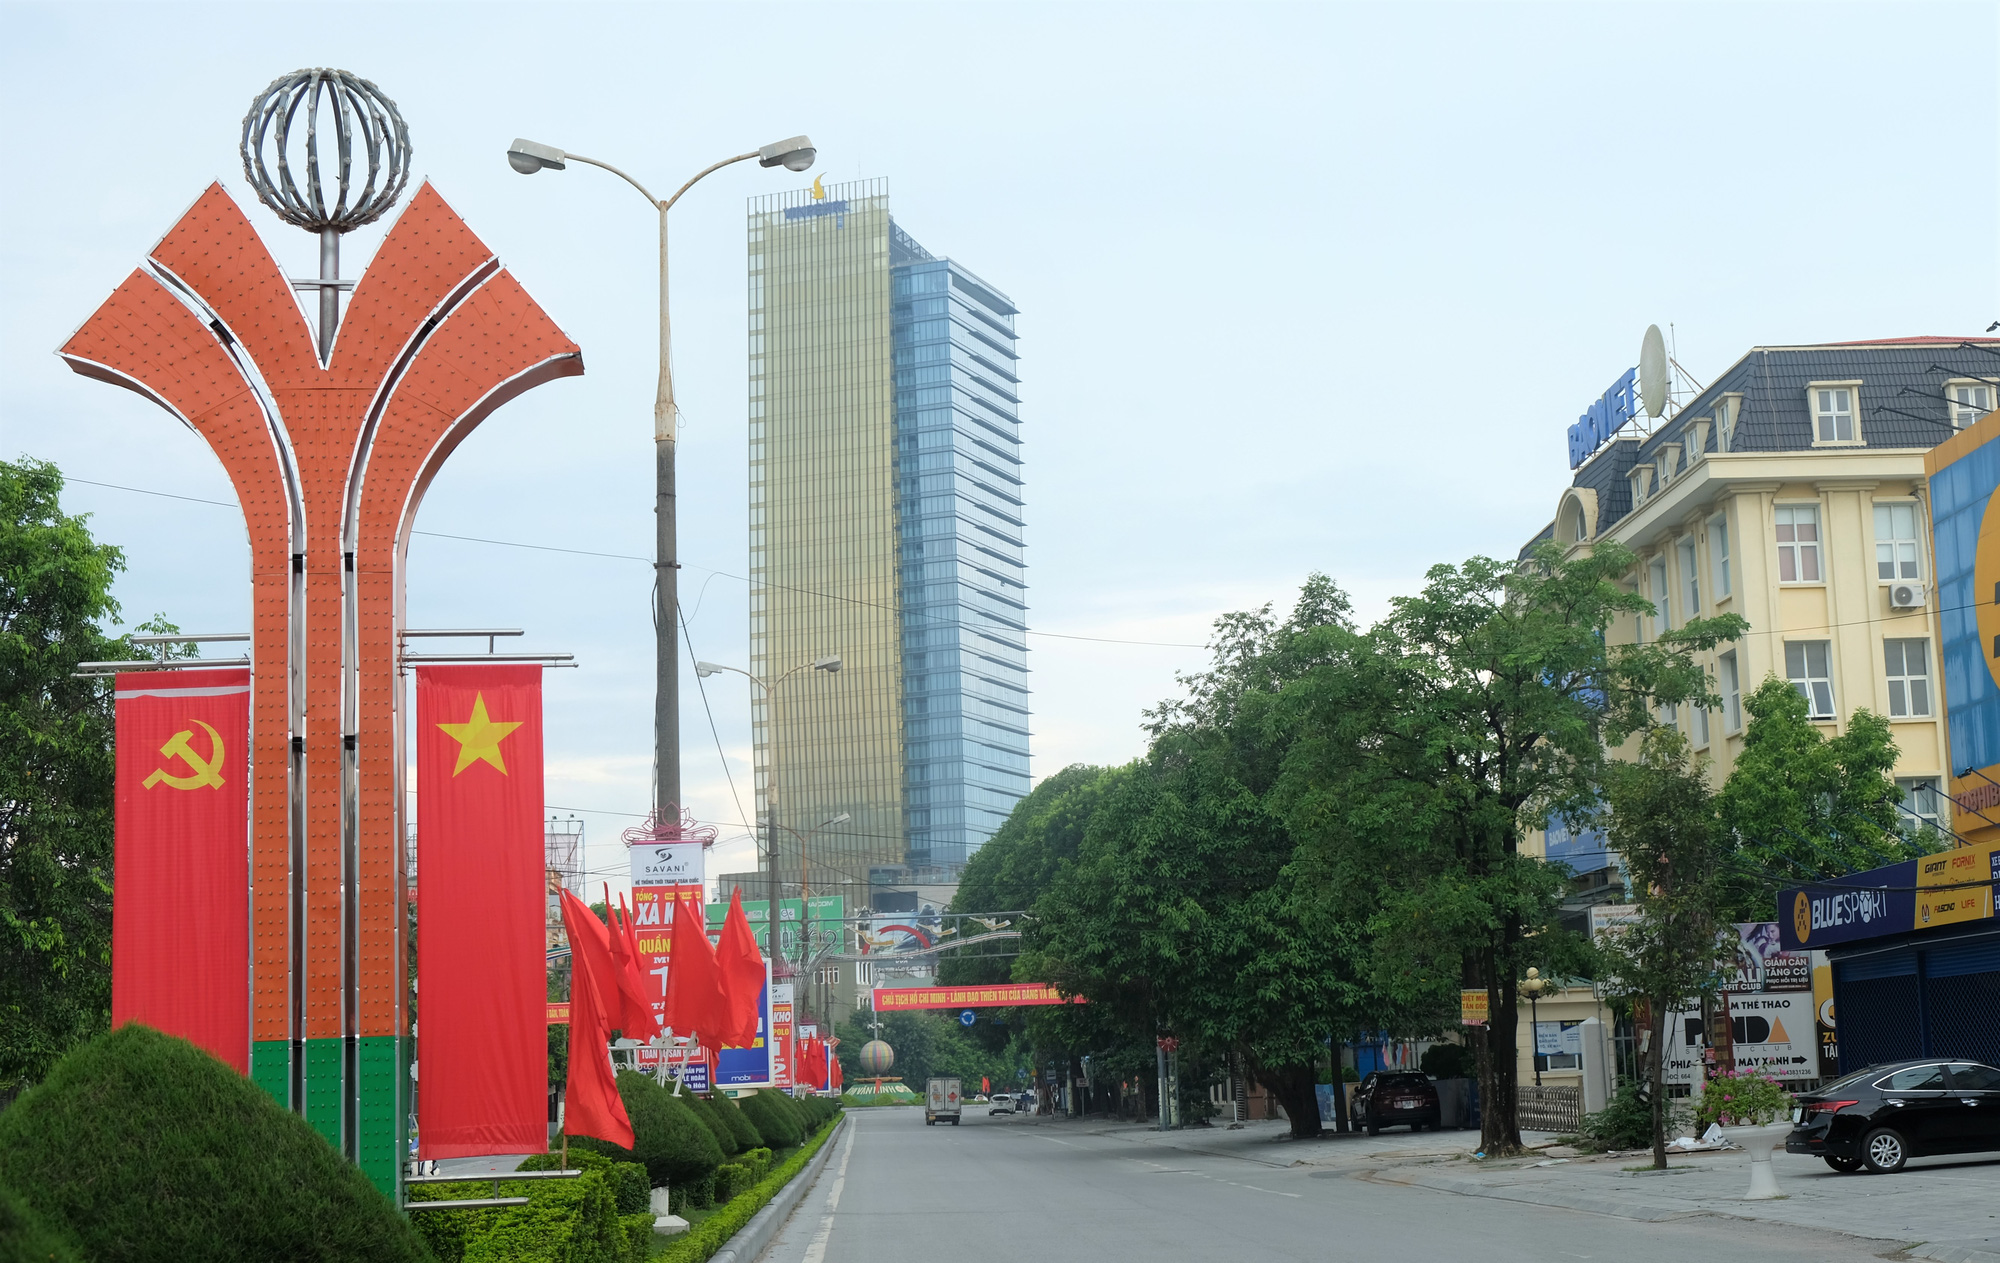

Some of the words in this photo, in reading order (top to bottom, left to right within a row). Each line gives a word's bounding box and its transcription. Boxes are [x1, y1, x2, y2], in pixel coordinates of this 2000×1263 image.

[1764, 958, 1787, 967] GIẢM
[1788, 957, 1806, 966] CÂN
[1766, 967, 1790, 976] TĂNG
[1762, 1000, 1790, 1009] THAO
[774, 1011, 791, 1022] KHO
[1685, 1016, 1790, 1045] PNDA
